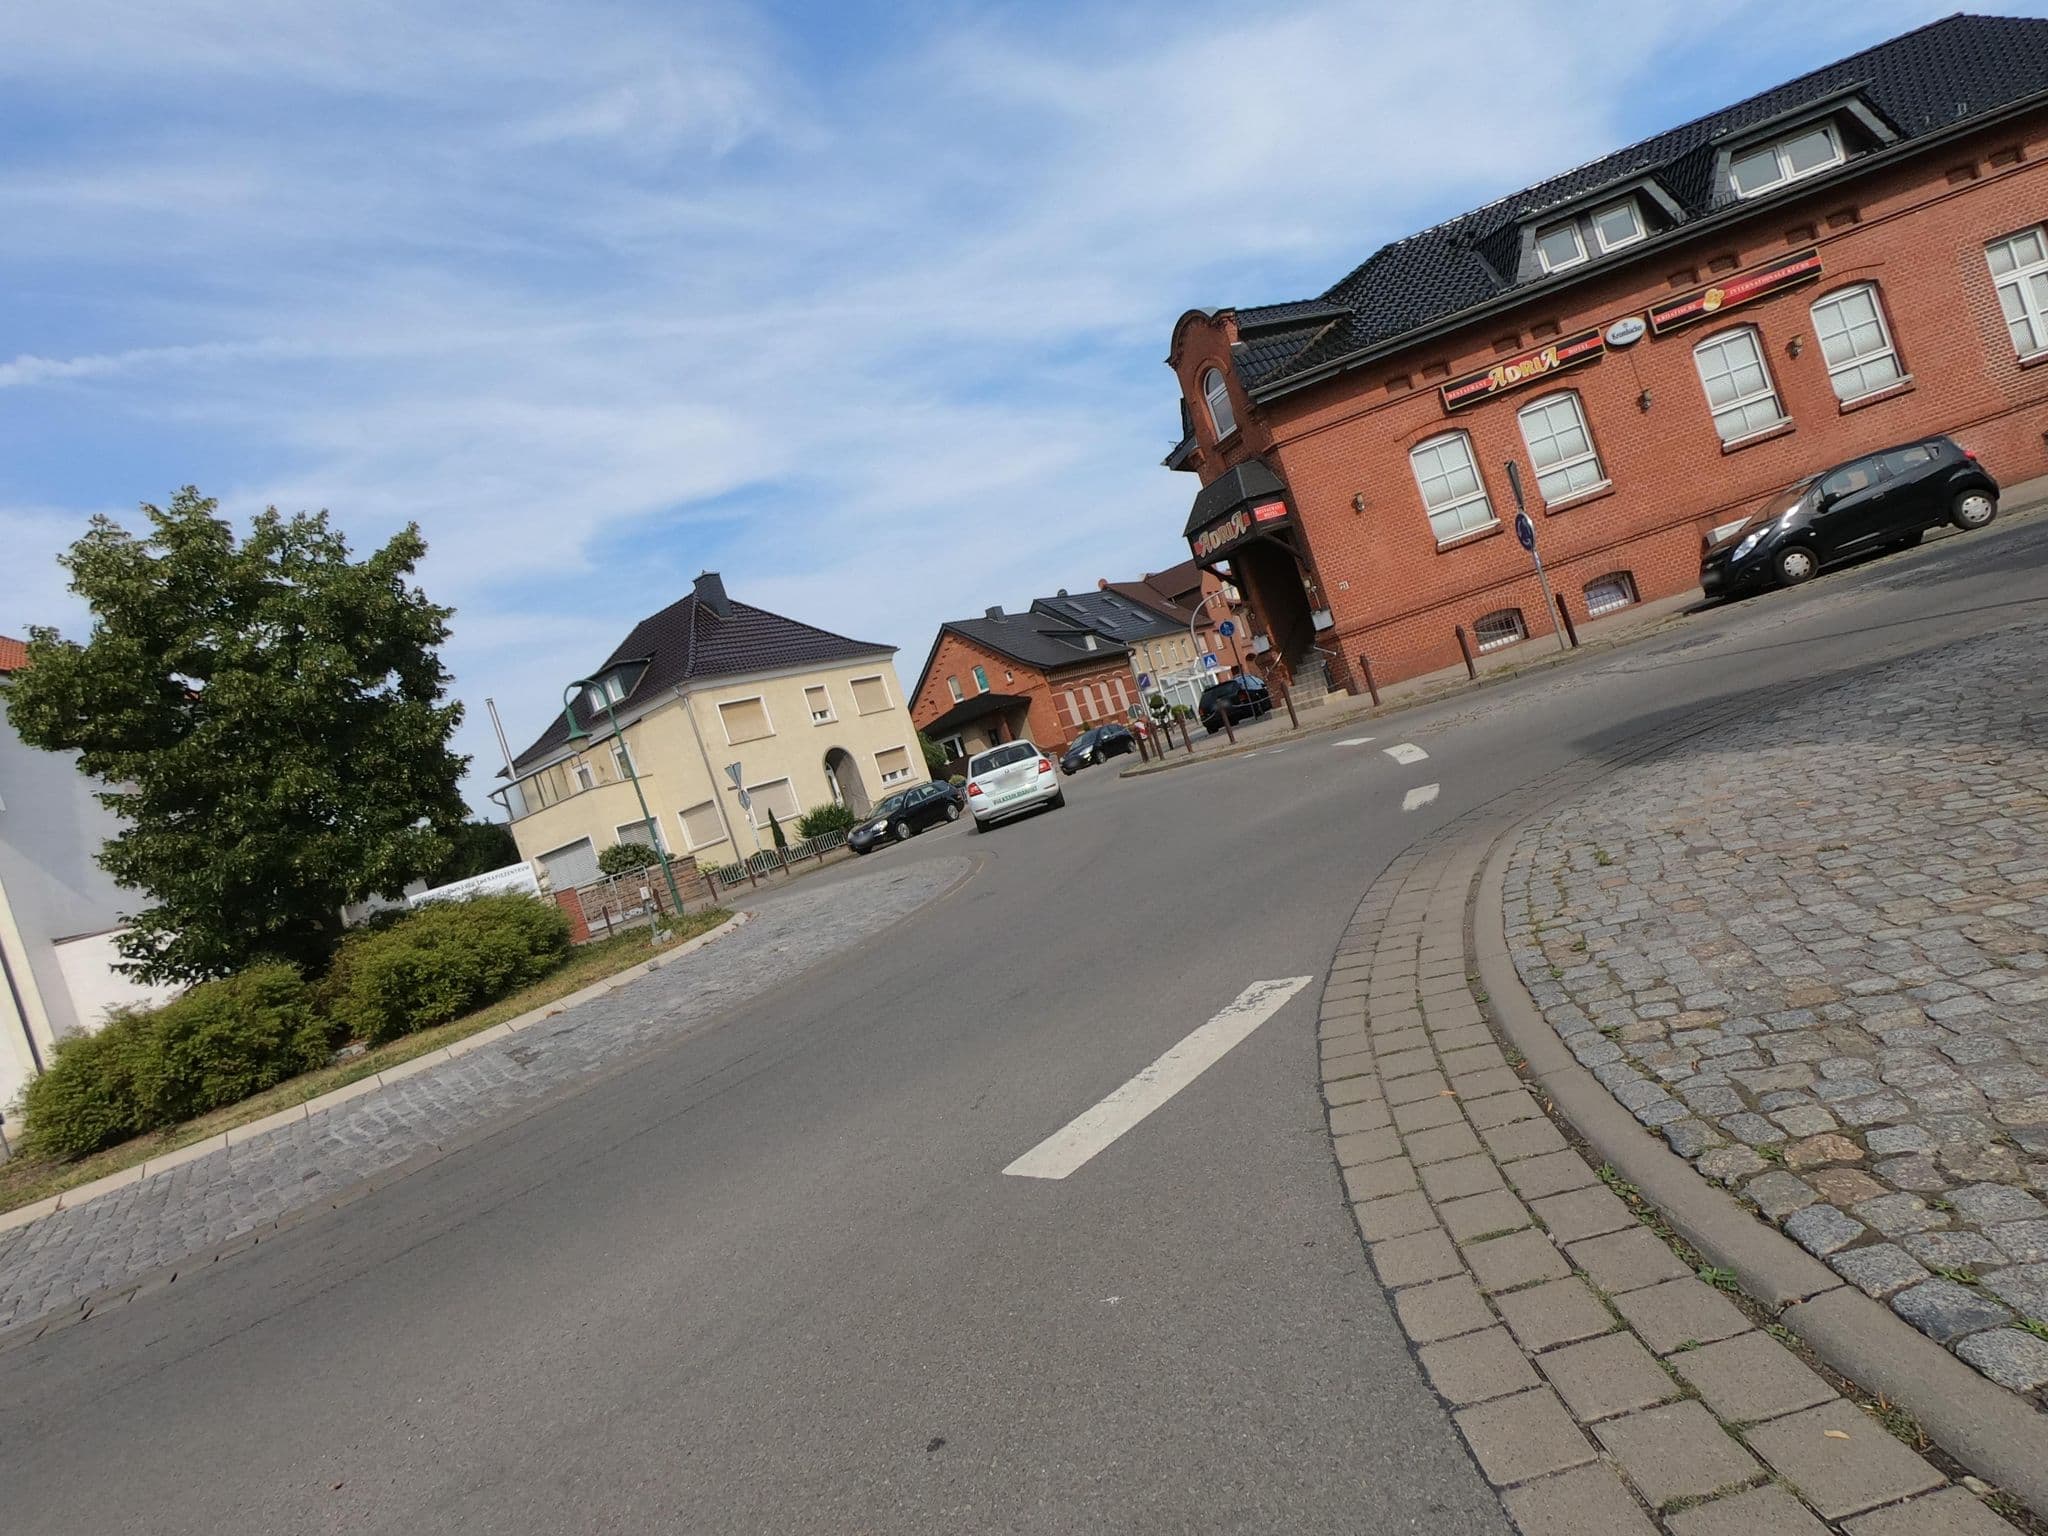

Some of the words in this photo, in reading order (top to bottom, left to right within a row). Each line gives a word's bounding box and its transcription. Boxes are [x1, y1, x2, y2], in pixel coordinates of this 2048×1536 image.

[1729, 270, 1786, 295] INTERNATIONALE
[1447, 381, 1488, 399] RESTAURANT
[1488, 346, 1561, 392] ADRIA
[1199, 511, 1247, 558] ADRIA
